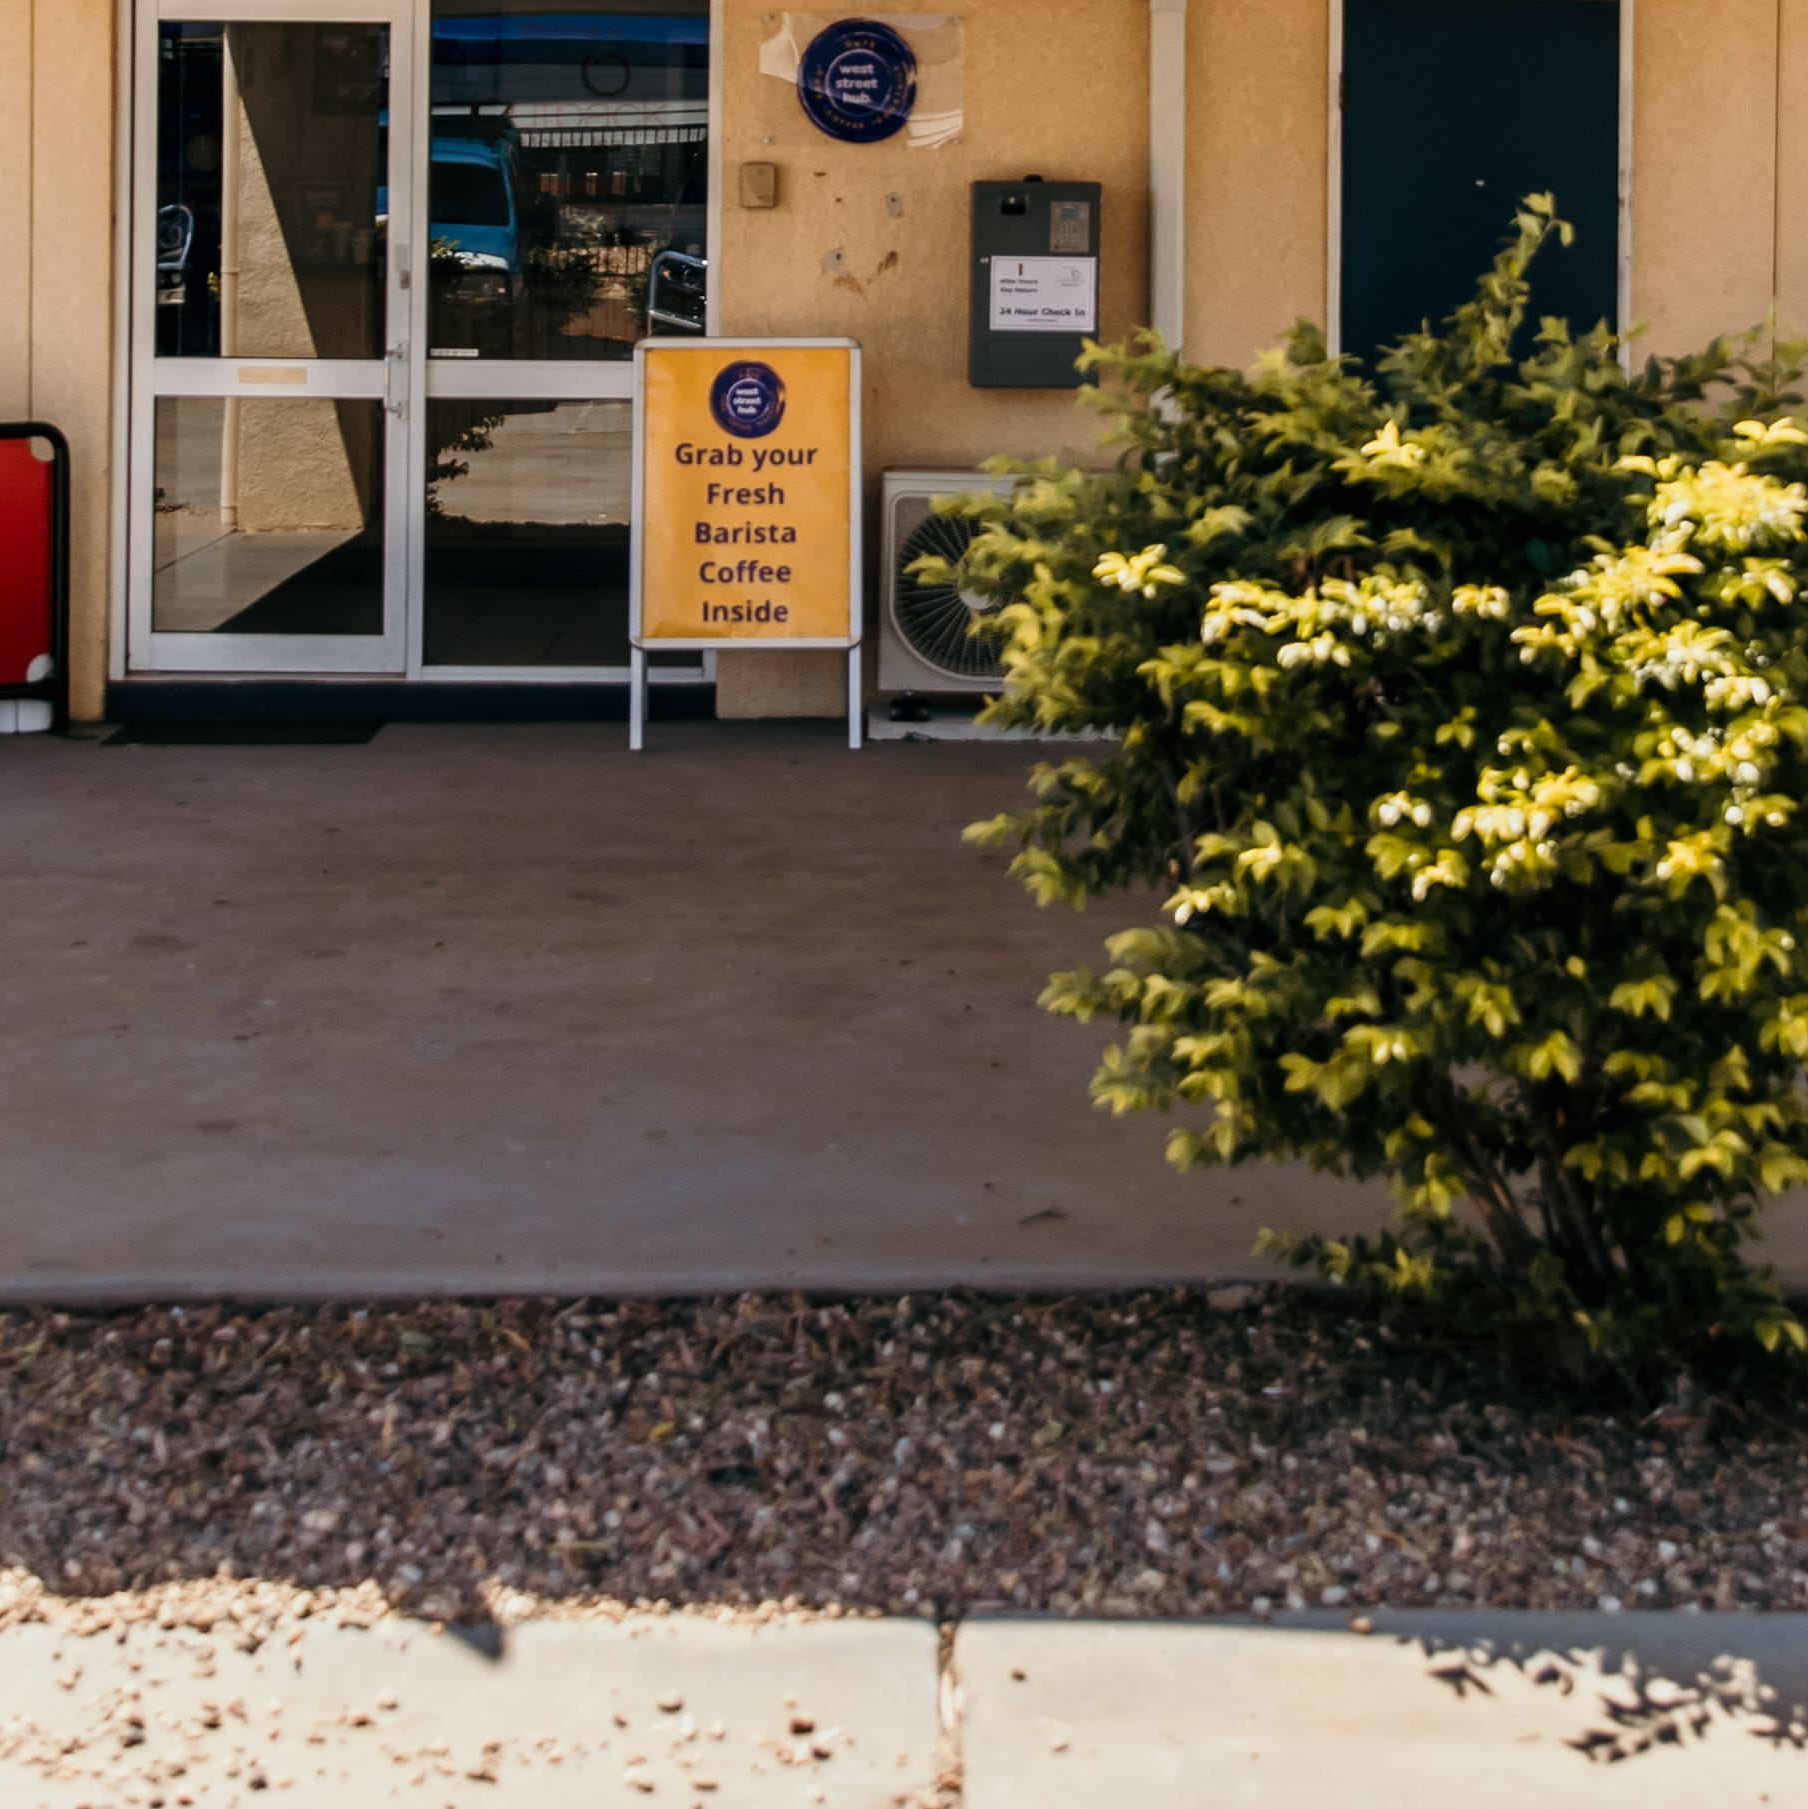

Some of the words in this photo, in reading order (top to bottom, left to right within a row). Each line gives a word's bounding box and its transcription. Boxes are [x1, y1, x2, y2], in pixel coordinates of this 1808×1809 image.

[839, 64, 875, 75] west
[835, 78, 878, 89] street
[1014, 307, 1039, 316] Hour
[1041, 308, 1071, 316] Check
[1074, 308, 1086, 316] In
[675, 443, 743, 466] Grab
[752, 449, 818, 472] your
[707, 482, 785, 505] Fresh
[695, 521, 797, 544] Barista
[699, 560, 792, 584] Coffee
[702, 599, 789, 623] Inside
